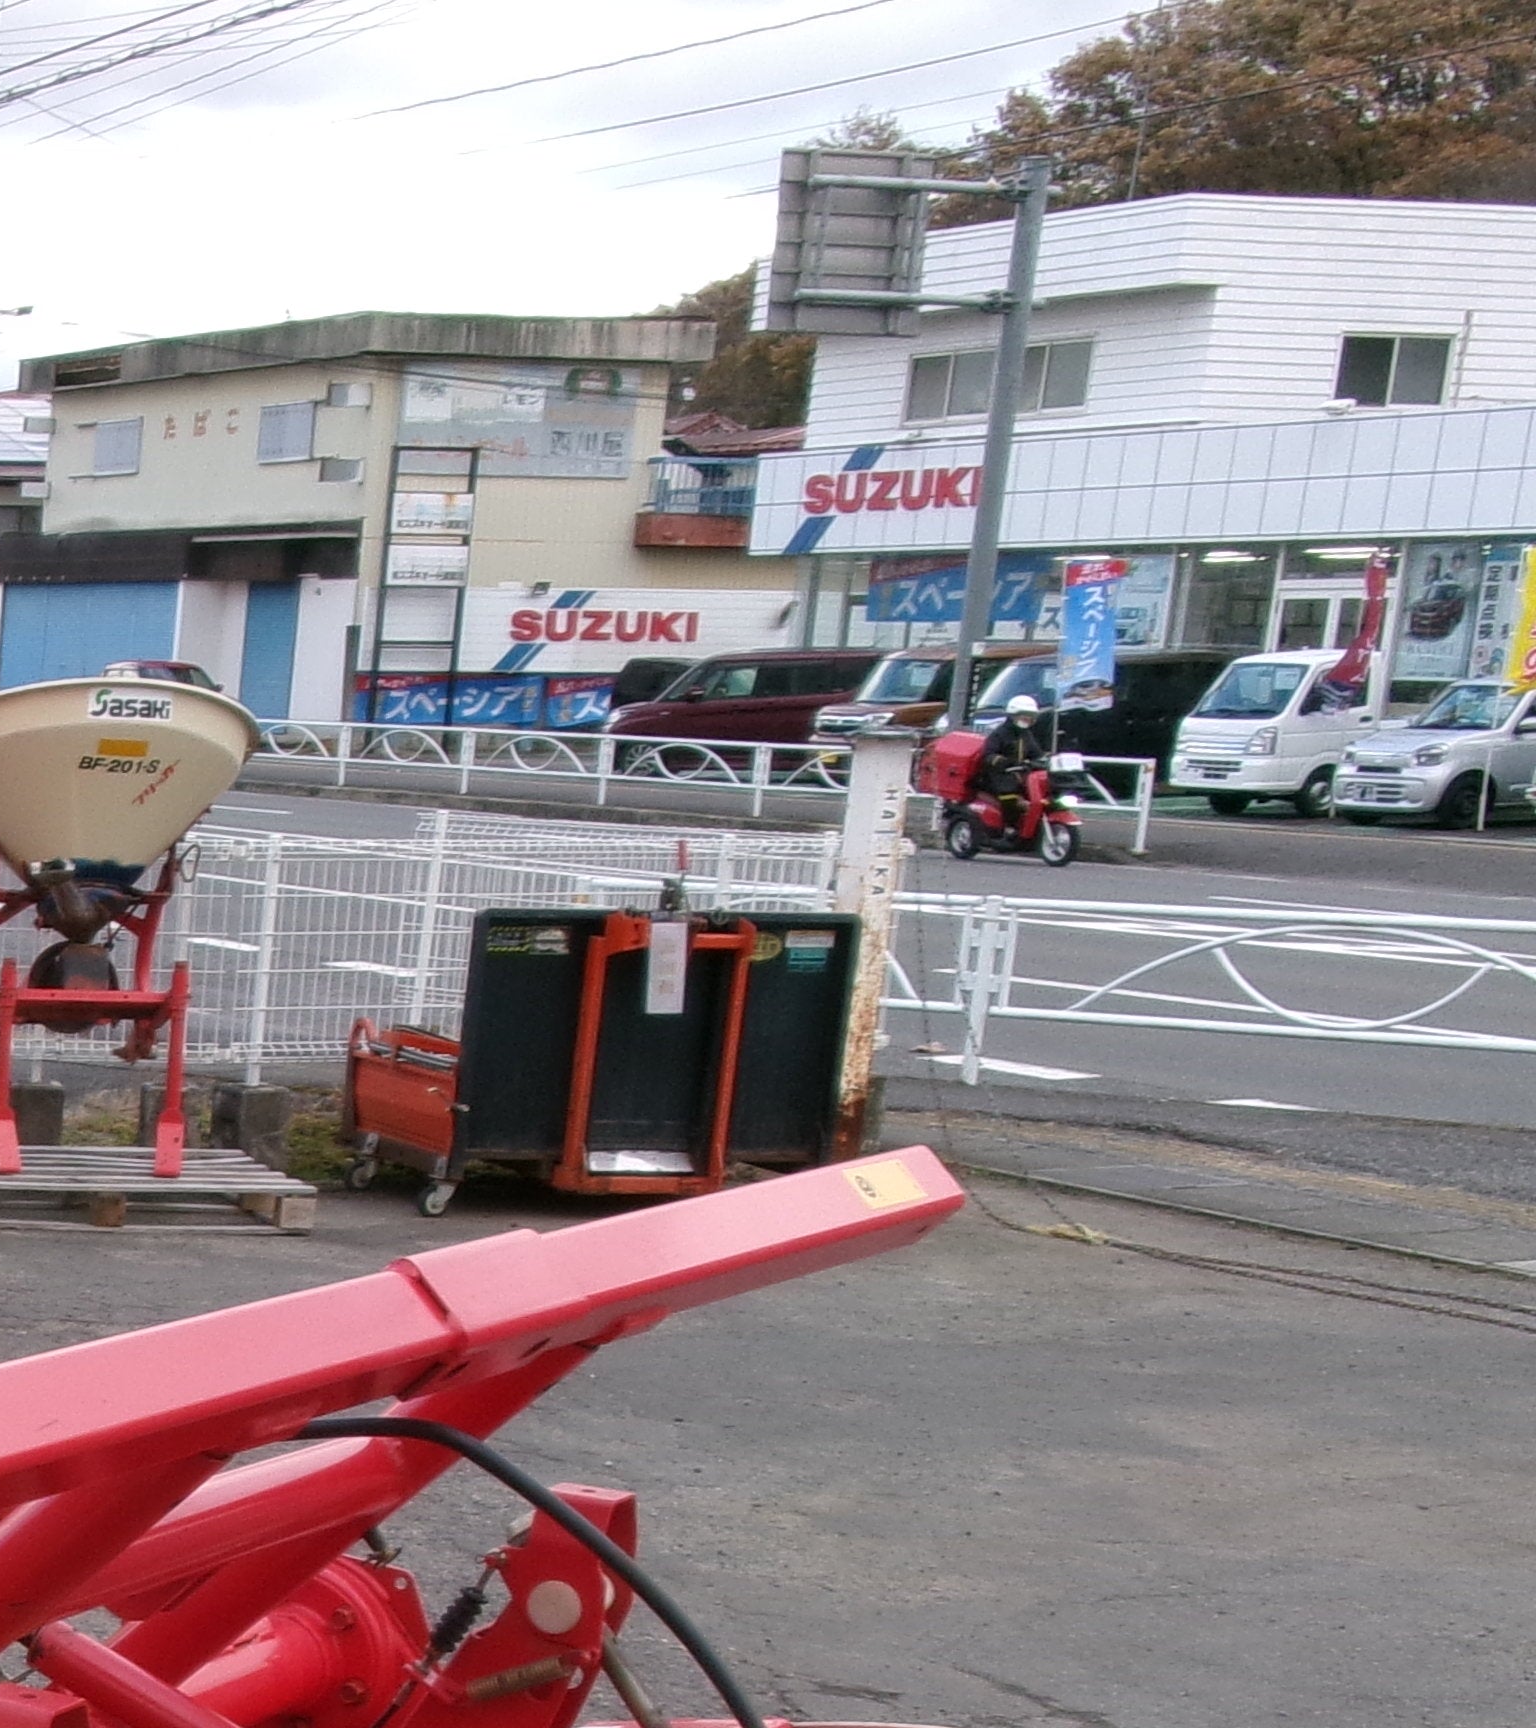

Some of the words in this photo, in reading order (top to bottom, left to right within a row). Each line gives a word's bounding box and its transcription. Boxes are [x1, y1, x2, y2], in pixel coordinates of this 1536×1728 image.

[803, 466, 983, 514] SUZUKI
[891, 570, 1035, 618] スペーア
[509, 609, 700, 642] SUZUKI
[89, 688, 172, 720] Sasaki
[78, 756, 161, 774] BF-201-S
